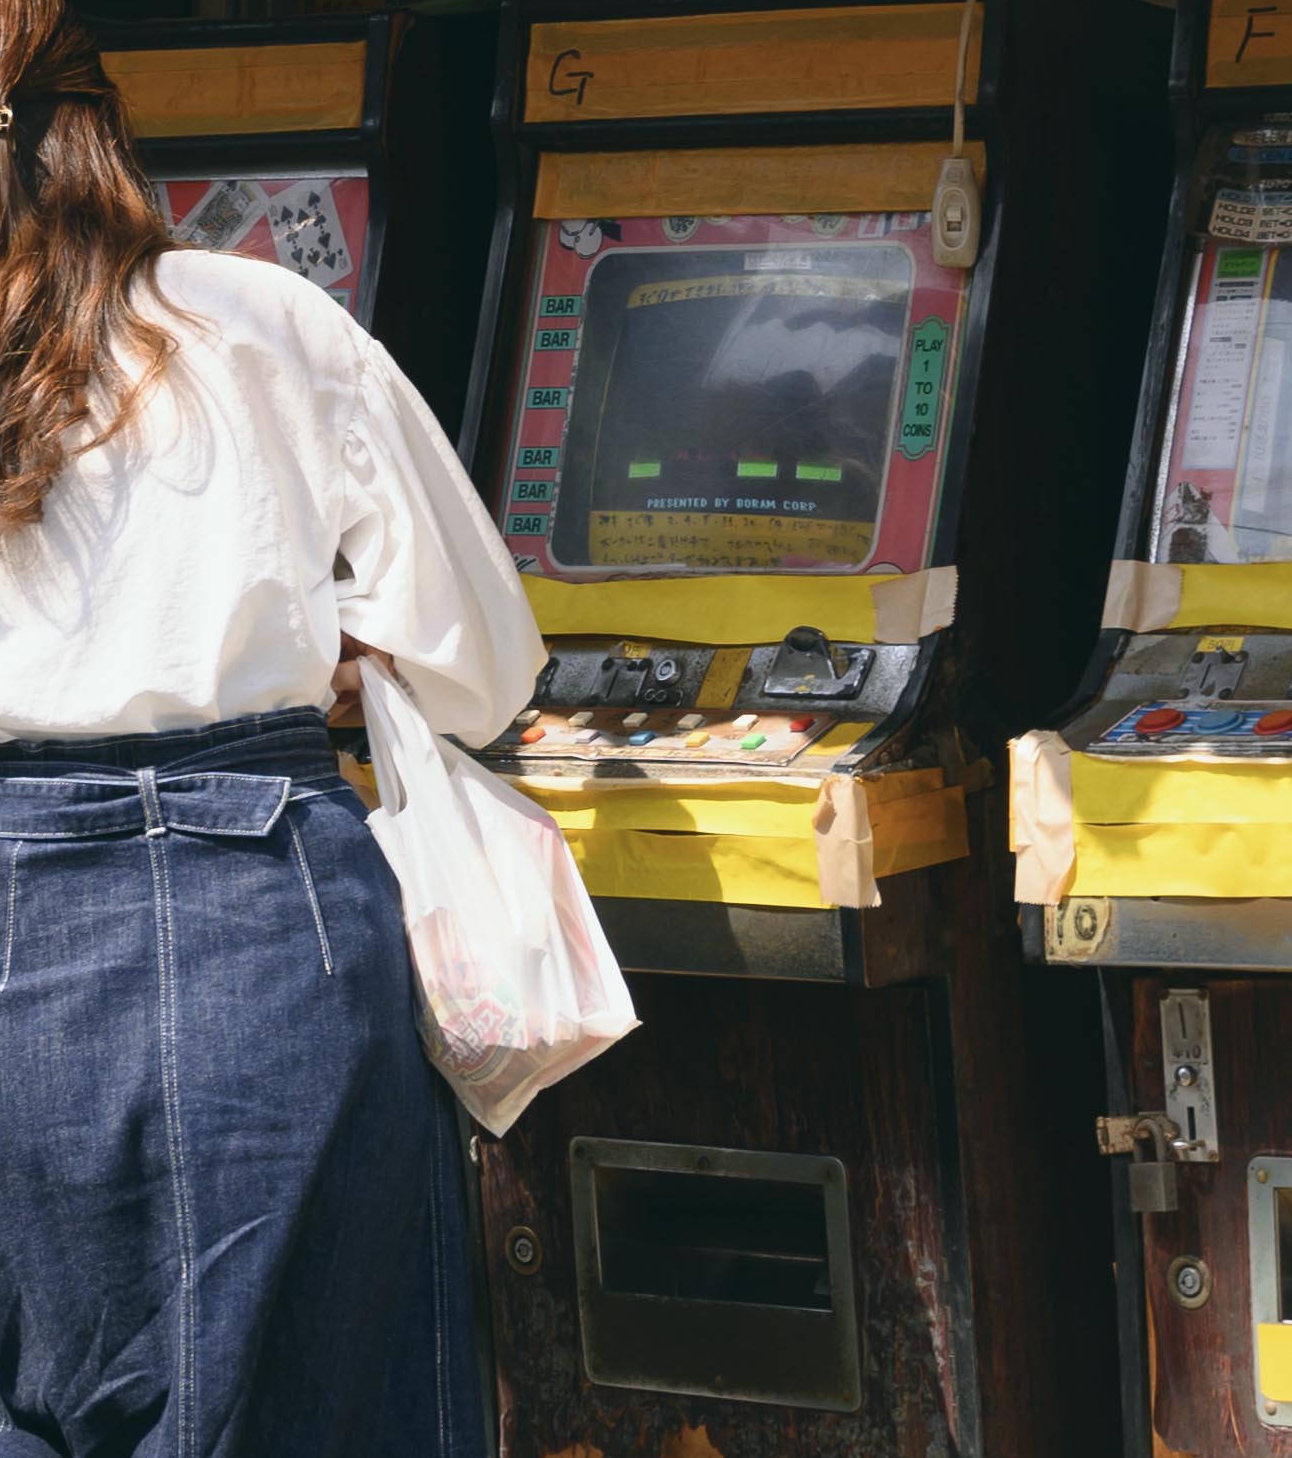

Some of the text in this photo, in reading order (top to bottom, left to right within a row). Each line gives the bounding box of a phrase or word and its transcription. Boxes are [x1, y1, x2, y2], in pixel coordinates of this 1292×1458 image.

[1235, 6, 1277, 63] F
[549, 49, 595, 106] G
[1218, 202, 1256, 216] HOLD2
[1215, 214, 1253, 228] HOLD3
[1212, 226, 1250, 238] HOLD4
[546, 297, 575, 314] BAR
[540, 332, 571, 348] BAR
[915, 339, 943, 352] PLAY
[923, 359, 929, 372] 1
[915, 381, 933, 395] TO
[532, 390, 562, 406] BAR
[915, 403, 929, 416] 10
[903, 424, 932, 437] COINS
[522, 449, 553, 465] BAR
[517, 483, 548, 500] BAR
[647, 497, 708, 510] PRESENTED
[714, 498, 730, 509] BY
[736, 498, 776, 510] BORAM
[512, 517, 542, 533] BAR
